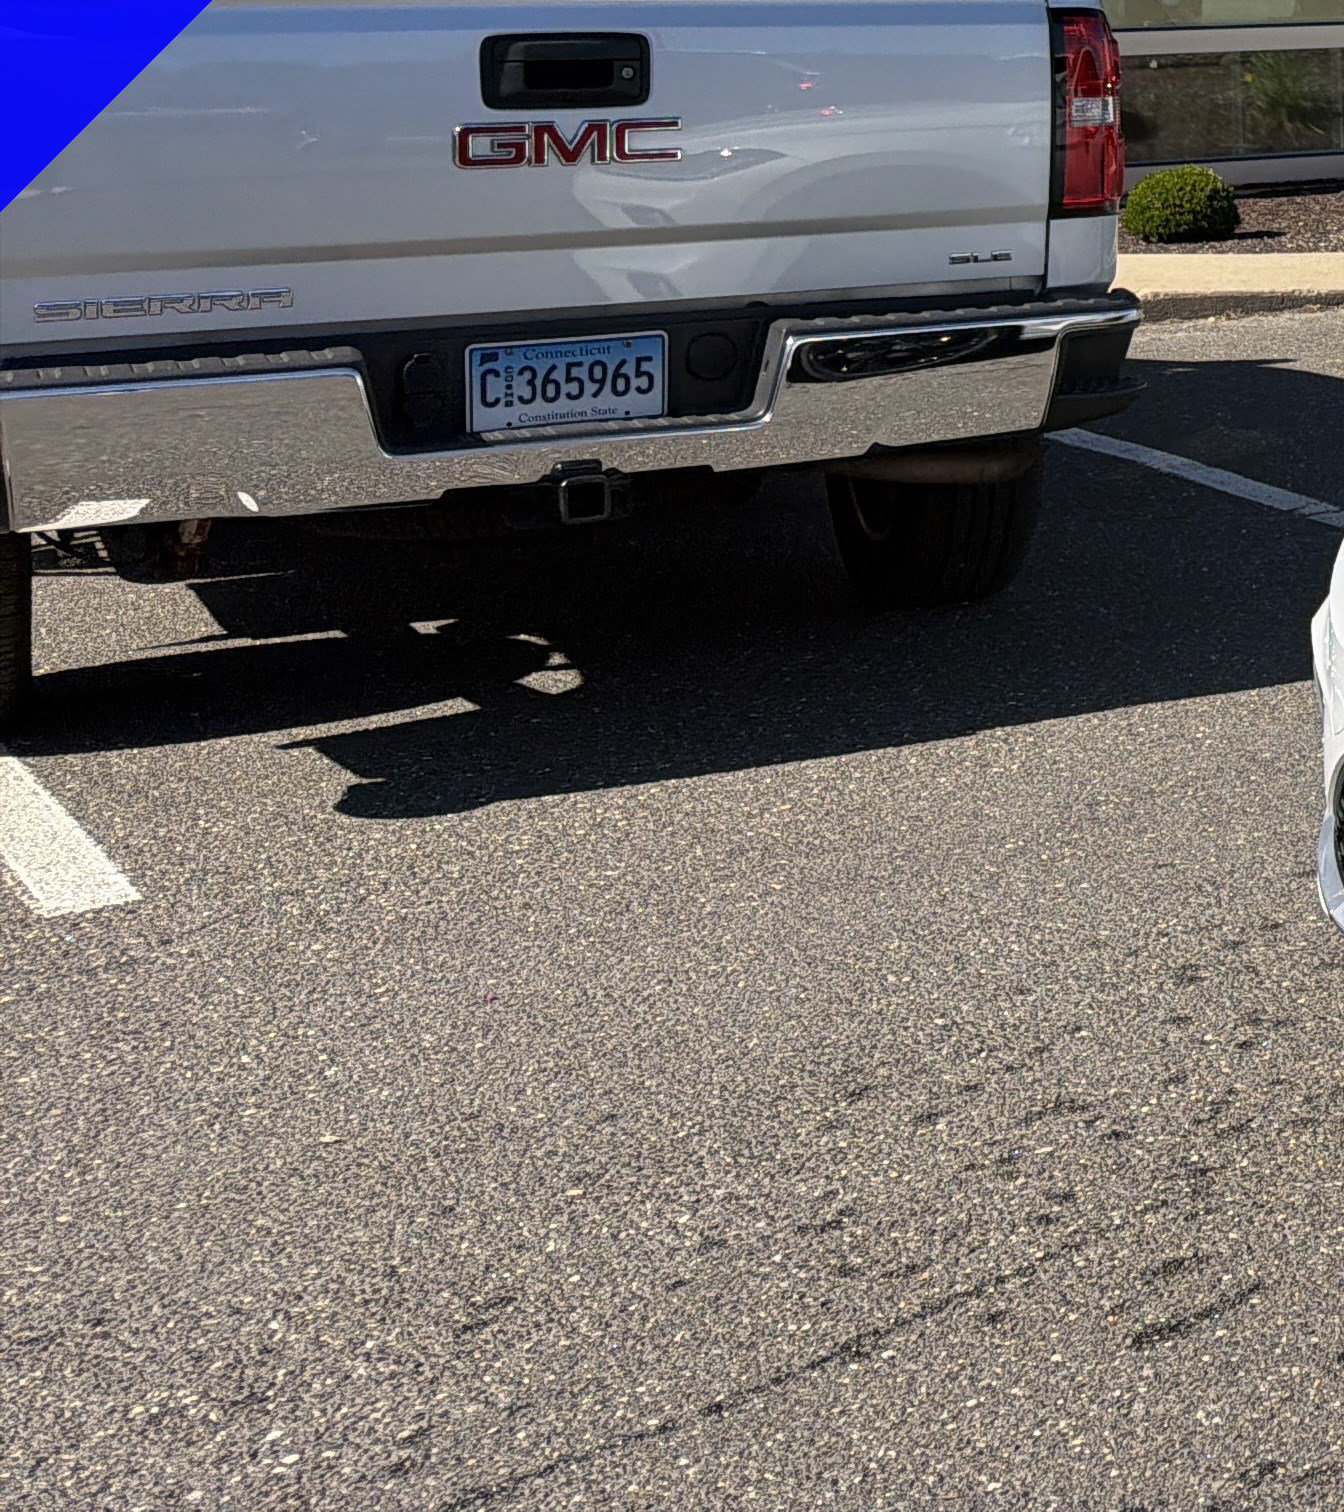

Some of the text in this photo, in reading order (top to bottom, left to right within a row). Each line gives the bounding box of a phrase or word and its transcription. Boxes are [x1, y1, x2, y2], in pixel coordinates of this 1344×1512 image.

[452, 116, 682, 170] GMC
[948, 248, 1013, 265] SLE
[33, 286, 294, 324] SIERRA
[523, 344, 612, 361] Connecticut
[518, 405, 618, 424] Constitution State
